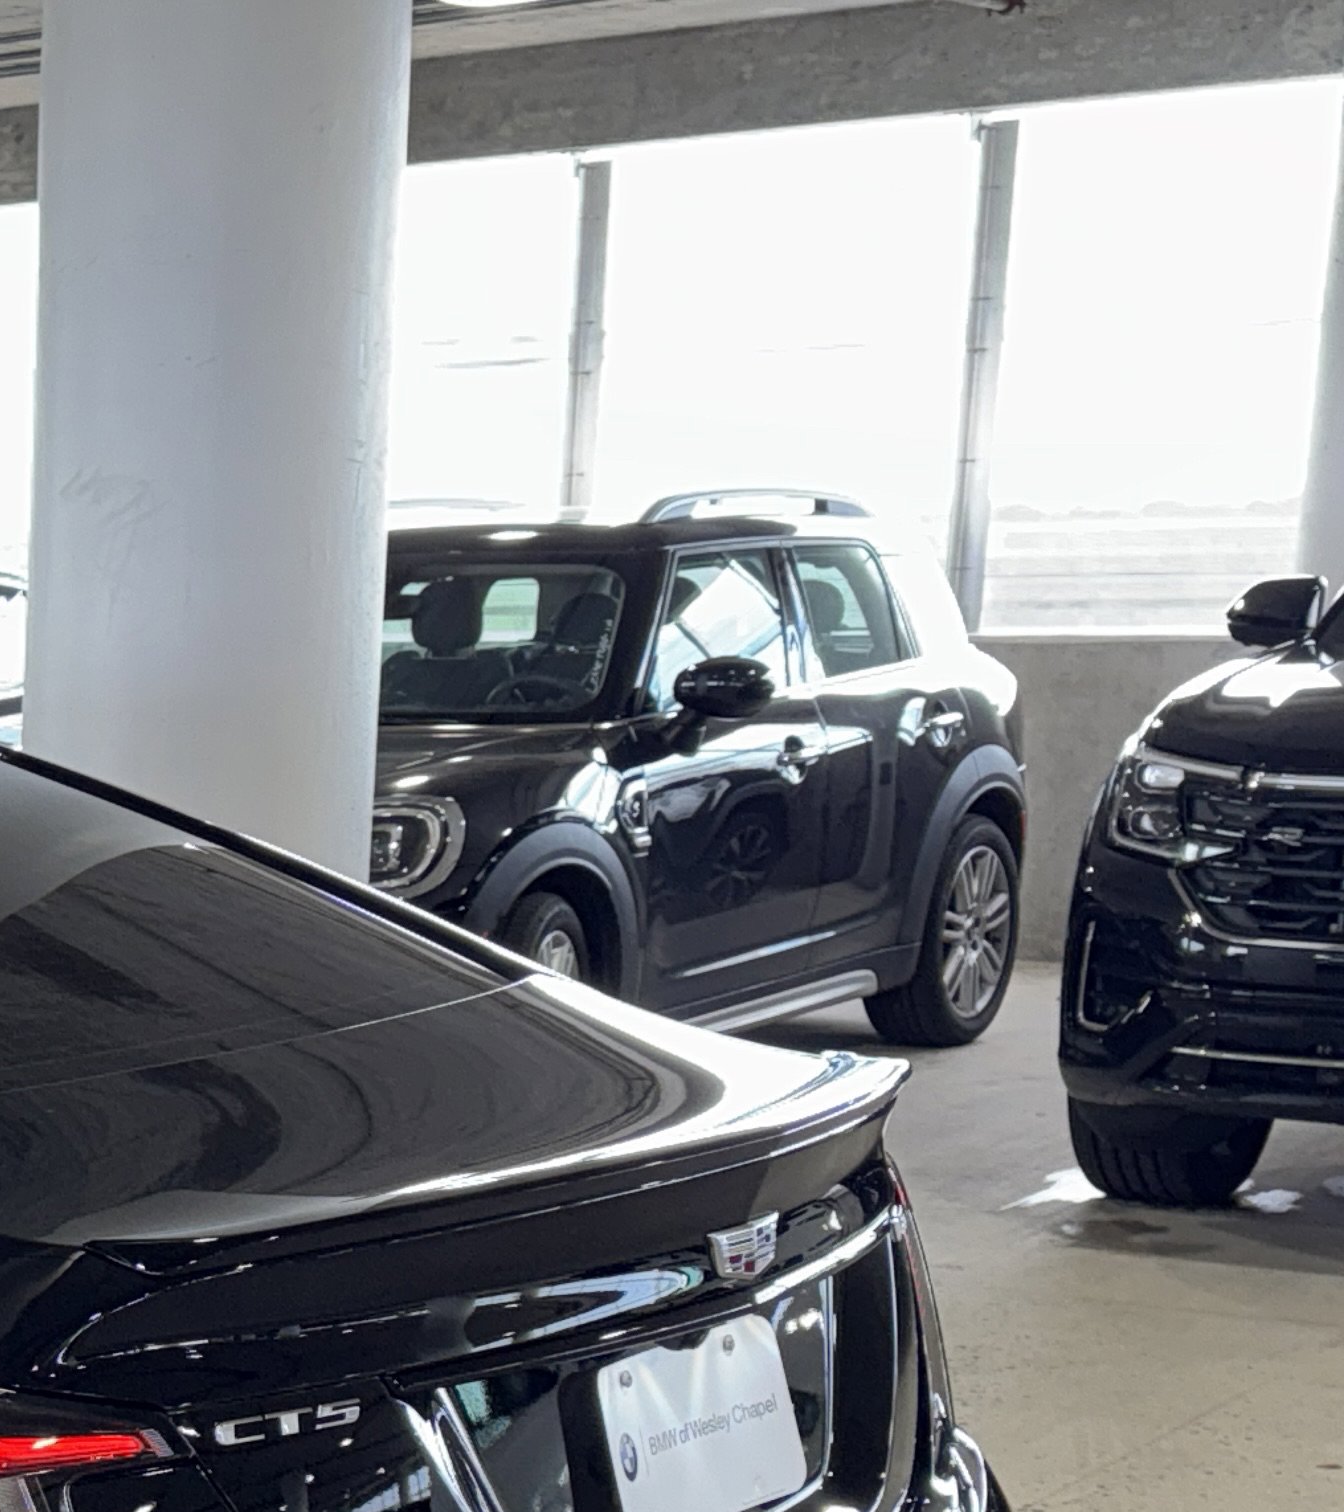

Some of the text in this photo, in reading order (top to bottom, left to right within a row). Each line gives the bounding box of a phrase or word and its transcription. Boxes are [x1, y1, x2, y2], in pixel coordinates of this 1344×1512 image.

[214, 1398, 361, 1446] CT5
[649, 1394, 778, 1455] BMW of Wesley Chapel
